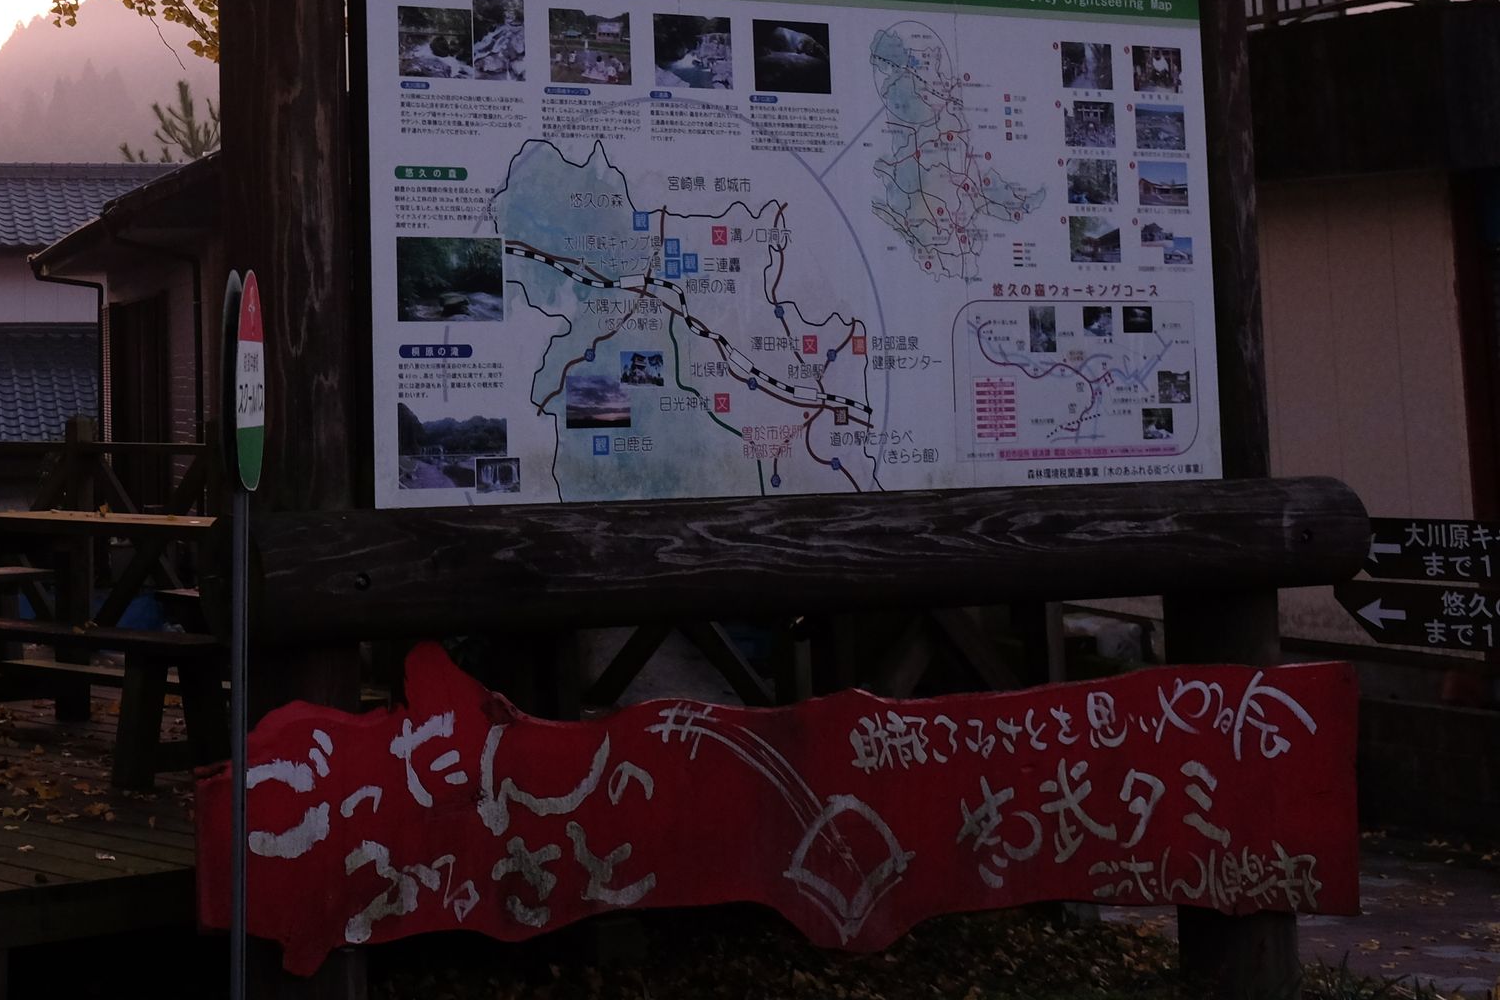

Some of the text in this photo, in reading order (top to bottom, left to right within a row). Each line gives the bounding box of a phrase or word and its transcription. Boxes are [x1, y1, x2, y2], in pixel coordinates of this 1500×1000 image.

[667, 175, 751, 193] 宮崎県 都城市
[570, 193, 624, 209] 悠久の森
[686, 279, 736, 294] 桐原の滝
[583, 299, 662, 315] 大隅大川原駅
[871, 336, 919, 352] 財部温泉
[690, 361, 729, 377] 北俣駅
[787, 363, 825, 379] 財部駅
[872, 355, 942, 371] 健康センター
[660, 396, 711, 412] 日光神社
[613, 436, 653, 453] 白鹿岳
[830, 430, 915, 447] 道の駅たからべ
[1404, 523, 1500, 550] 大川原キ
